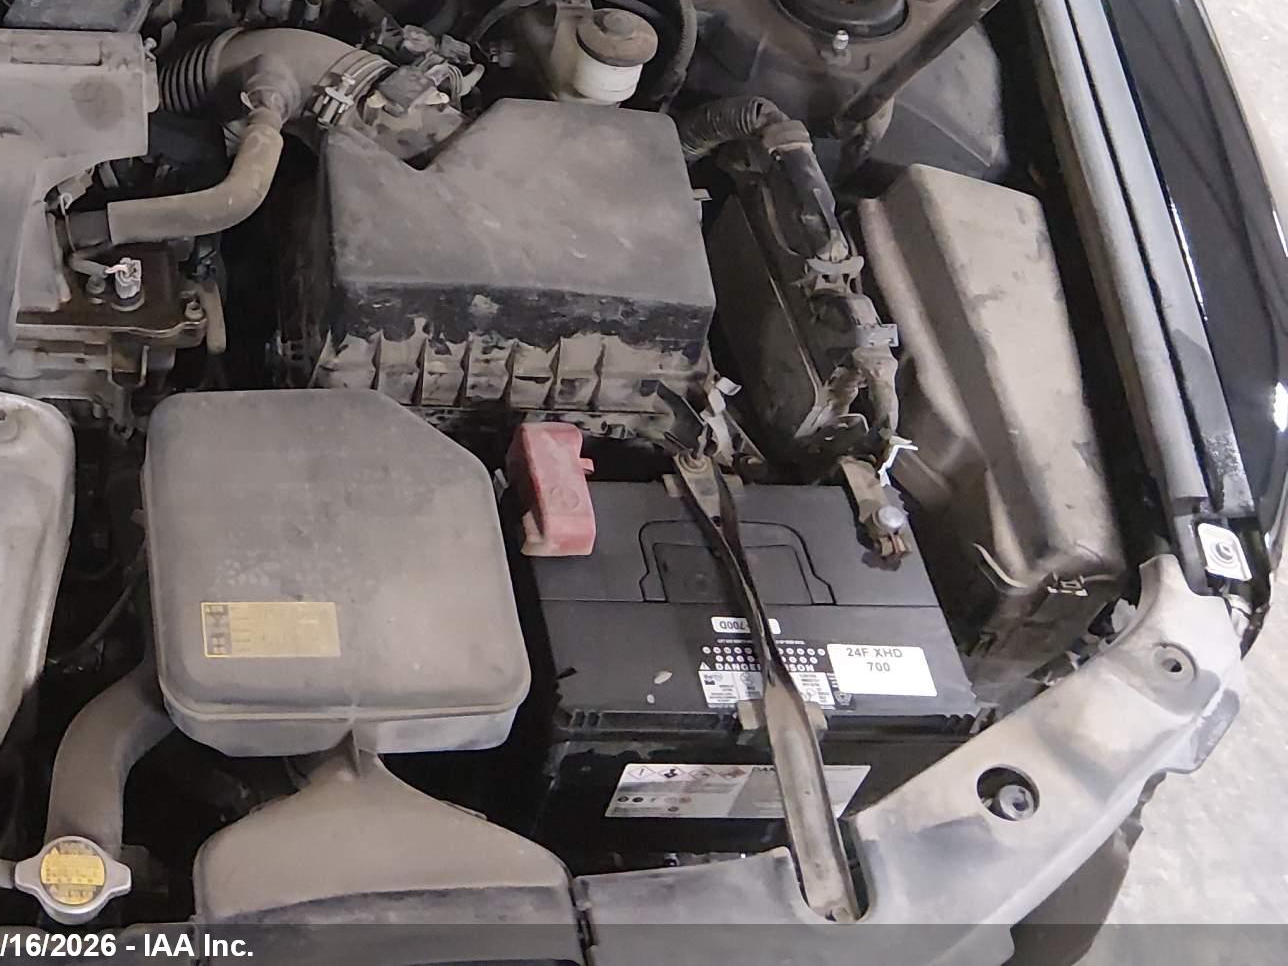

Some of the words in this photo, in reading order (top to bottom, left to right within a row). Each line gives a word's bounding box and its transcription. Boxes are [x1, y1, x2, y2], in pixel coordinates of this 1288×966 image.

[846, 647, 870, 657] 24F
[874, 648, 903, 658] XHD
[867, 661, 891, 672] 700
